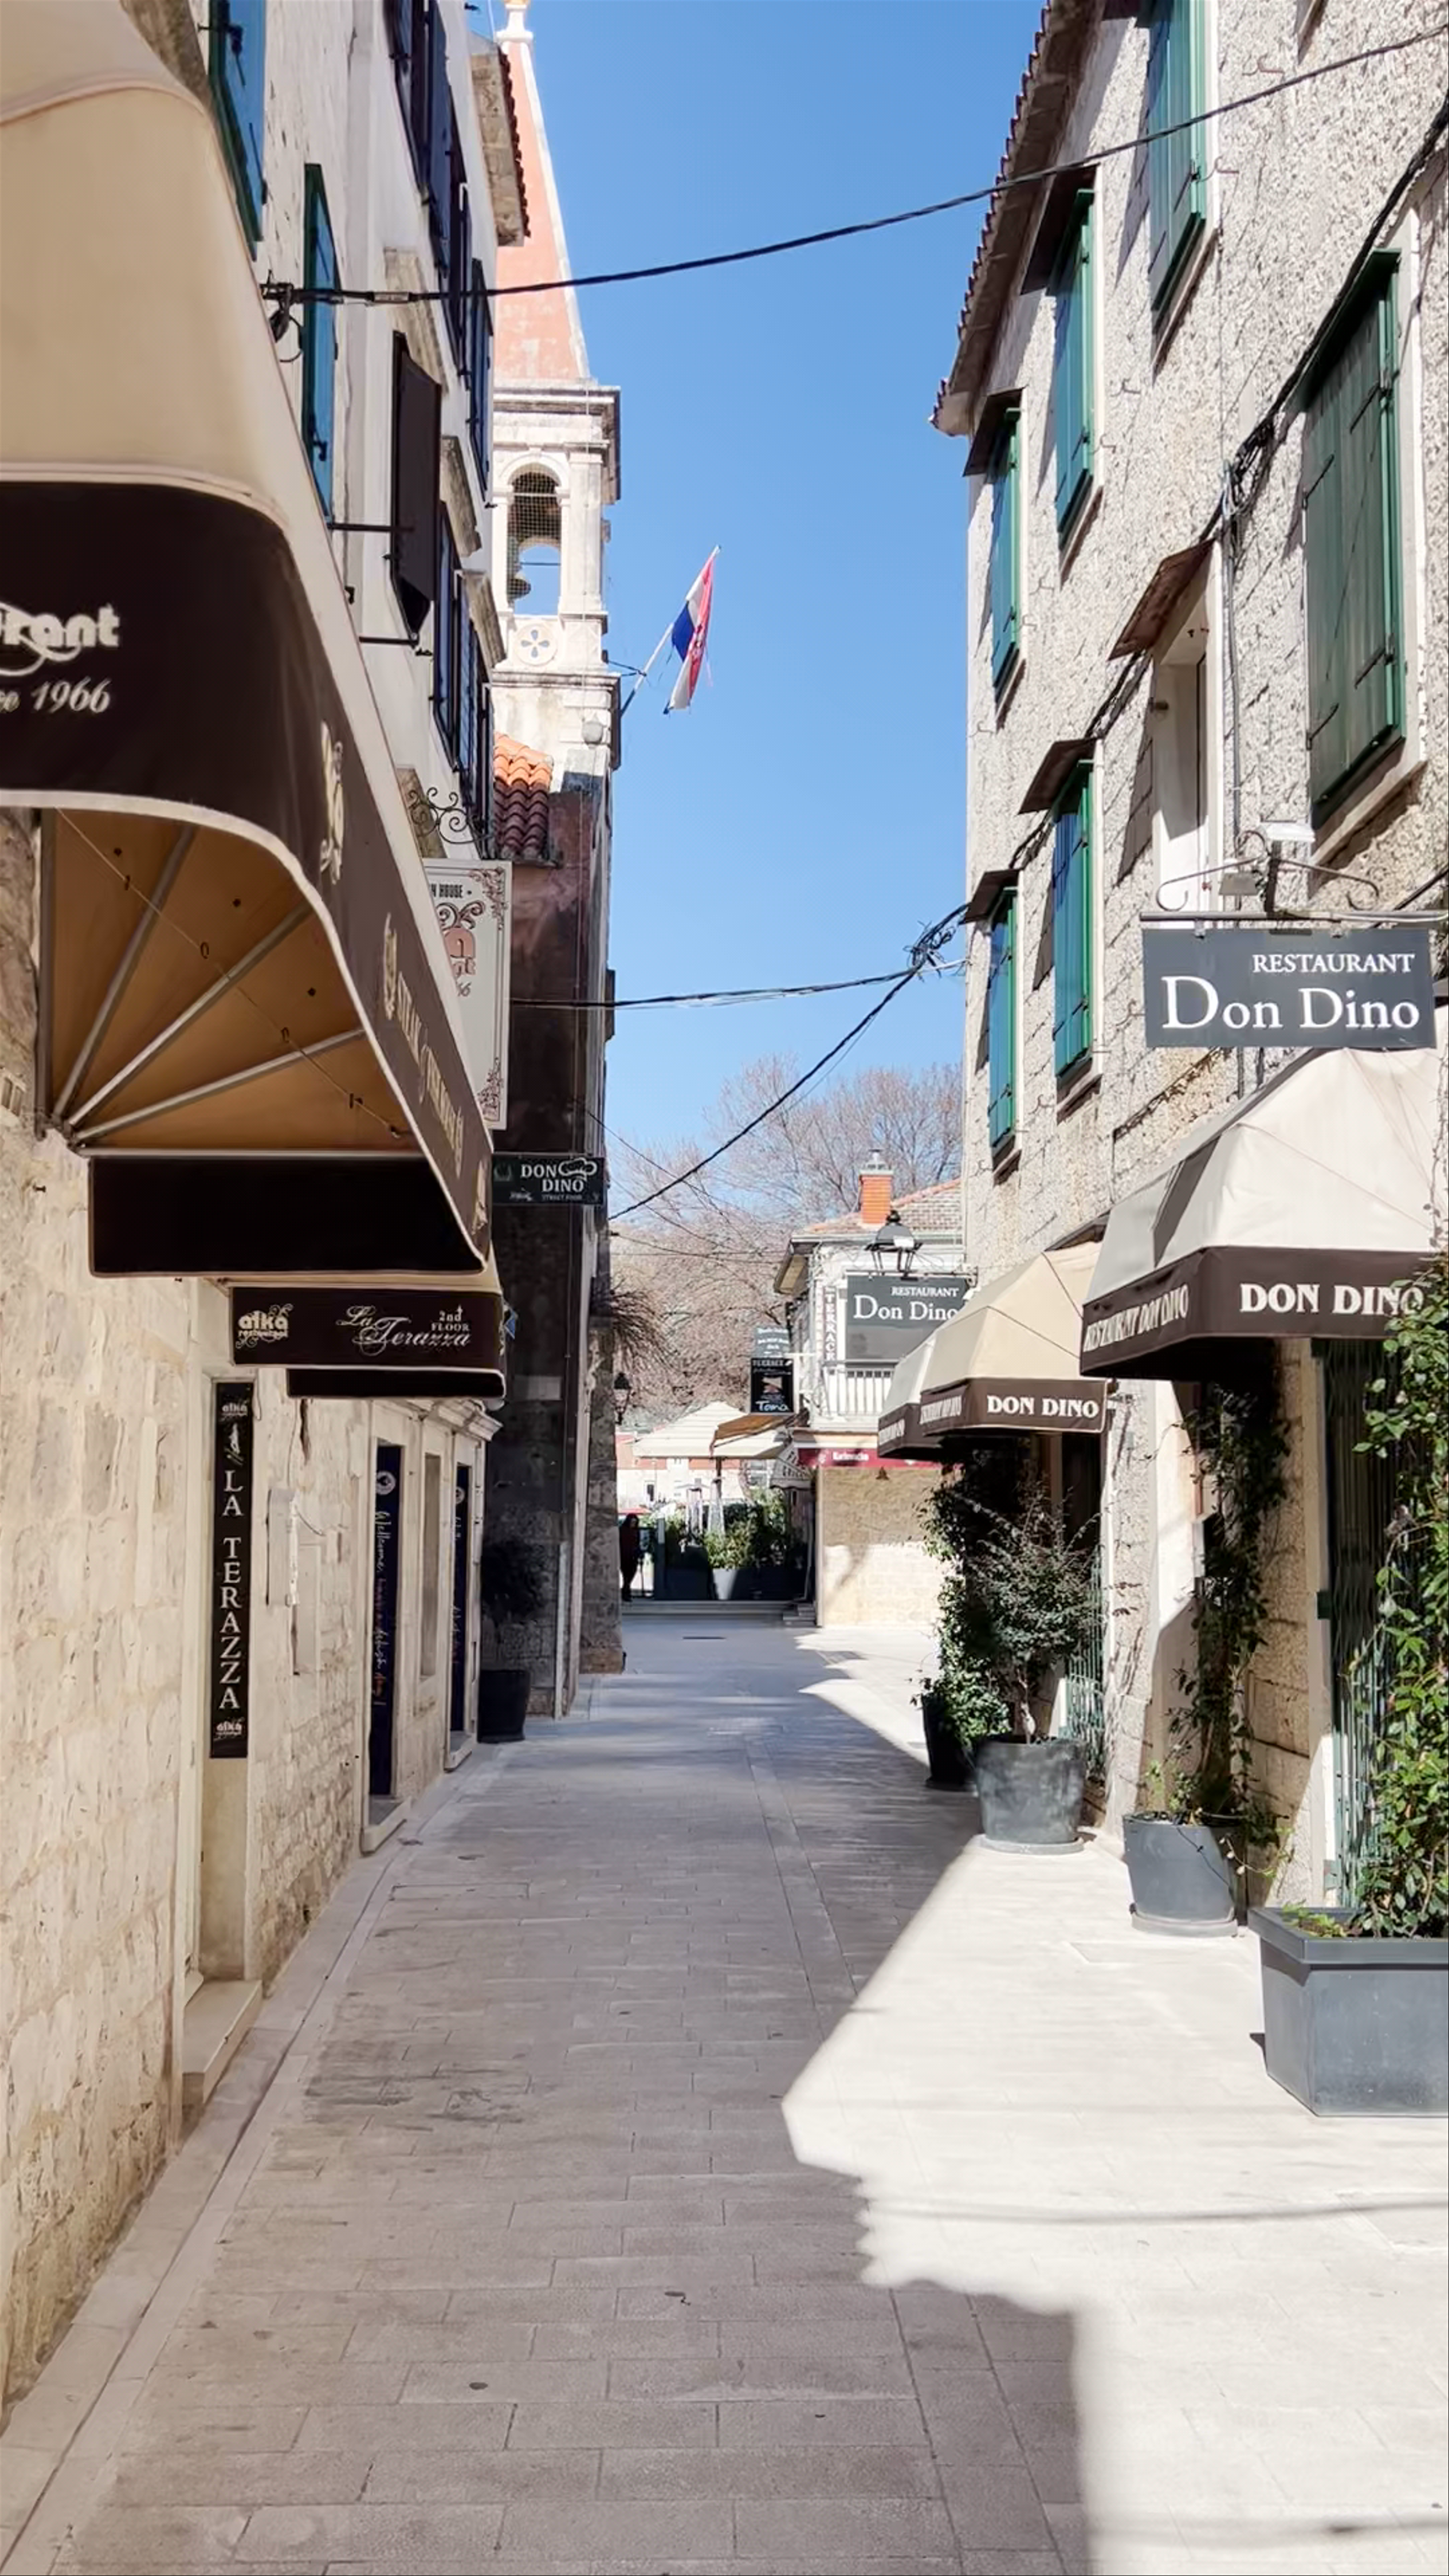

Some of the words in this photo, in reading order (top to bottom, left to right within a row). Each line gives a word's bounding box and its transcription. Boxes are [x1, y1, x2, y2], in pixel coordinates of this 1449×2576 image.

[0, 603, 120, 661] rant
[31, 677, 111, 713] 1966
[1252, 953, 1415, 973] RESTAURANT
[1161, 975, 1283, 1029] Don
[1299, 987, 1420, 1029] Dino
[521, 1164, 557, 1178] DON
[542, 1179, 584, 1192] DINO
[891, 1287, 959, 1297] RESTAURANT
[1239, 1283, 1320, 1313] DON
[1331, 1284, 1424, 1316] DINO
[335, 1305, 376, 1326] La
[853, 1294, 903, 1320] Don
[909, 1302, 958, 1320] Dino
[352, 1316, 471, 1356] Terazza
[431, 1322, 469, 1331] FLOOR
[987, 1395, 1035, 1415] DON
[1041, 1398, 1099, 1418] DINO
[222, 1470, 243, 1516] LA
[219, 1537, 242, 1709] TERAZZA
